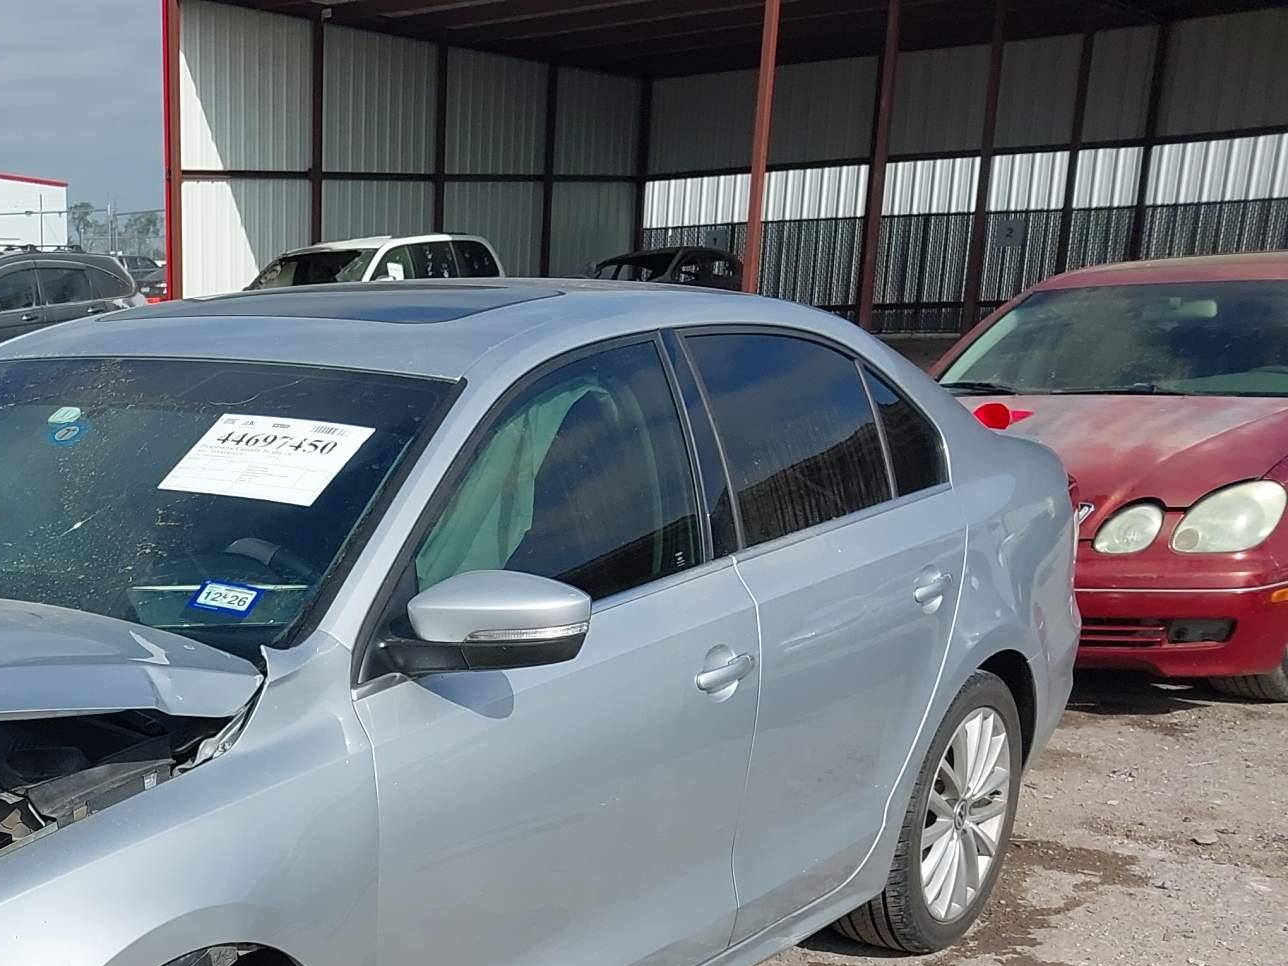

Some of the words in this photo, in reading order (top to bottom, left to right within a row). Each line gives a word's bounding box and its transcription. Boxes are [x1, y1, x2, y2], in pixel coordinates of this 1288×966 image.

[216, 430, 338, 456] 44697450
[204, 590, 223, 602] 12
[226, 595, 249, 607] 26
